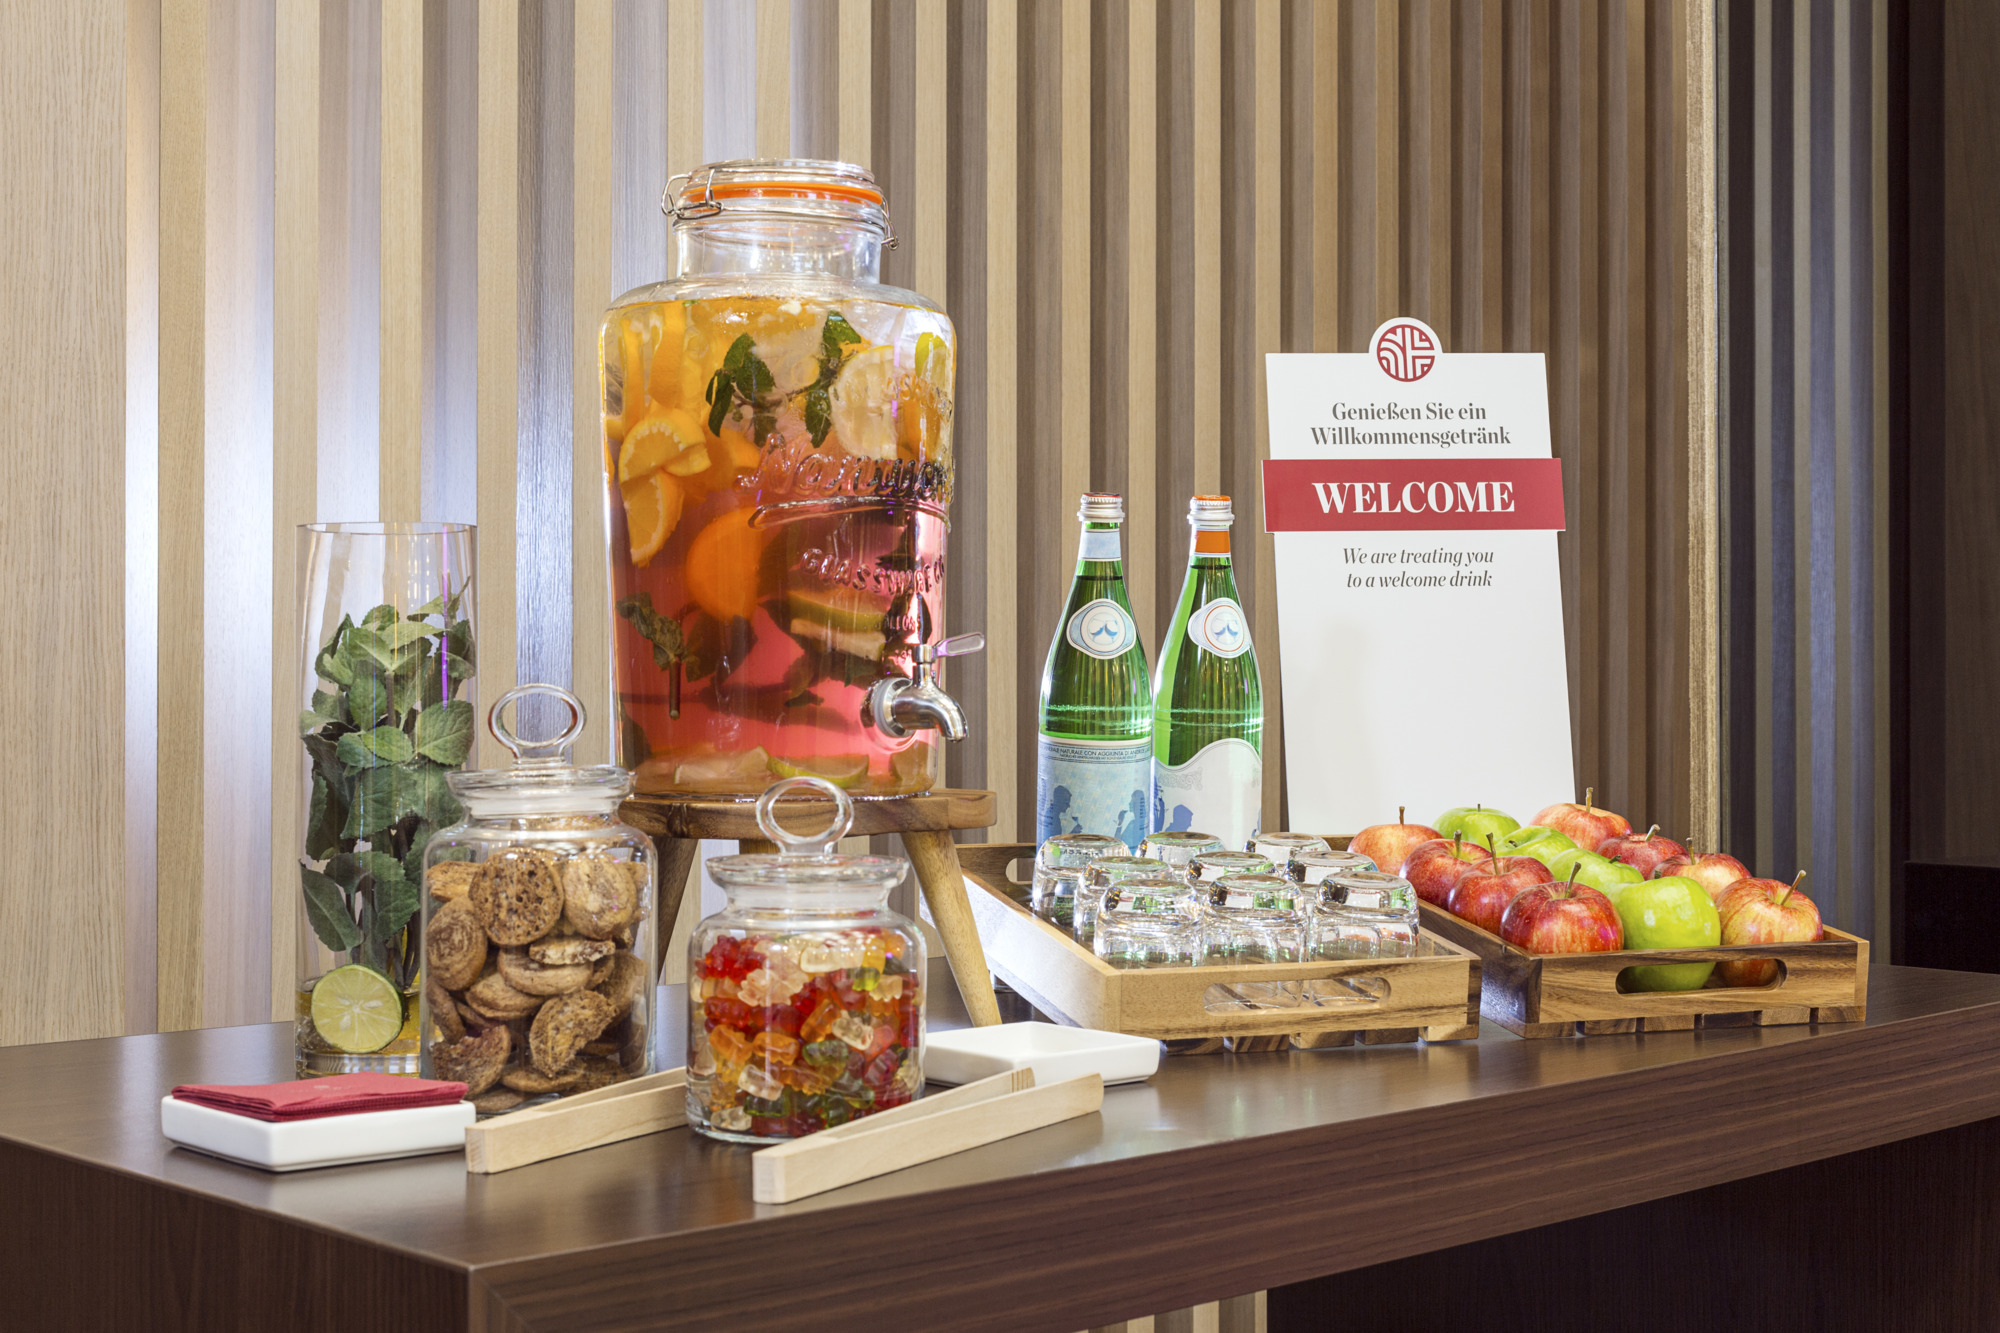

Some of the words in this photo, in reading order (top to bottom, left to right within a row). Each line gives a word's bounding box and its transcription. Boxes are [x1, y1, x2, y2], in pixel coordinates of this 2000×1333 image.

[1332, 402, 1422, 420] Genießen
[1426, 402, 1454, 419] Sie
[1459, 403, 1486, 419] ein
[1310, 426, 1511, 448] Willkommensgetränk
[1312, 481, 1515, 514] WELCOME
[1344, 548, 1367, 564] We
[1371, 553, 1396, 563] are
[1401, 548, 1462, 566] treating
[1465, 552, 1493, 567] you
[1348, 574, 1361, 587] to
[1366, 577, 1374, 587] a
[1380, 571, 1446, 587] welcome
[1450, 570, 1492, 586] drink
[1098, 749, 1124, 757] AGGIUNTA
